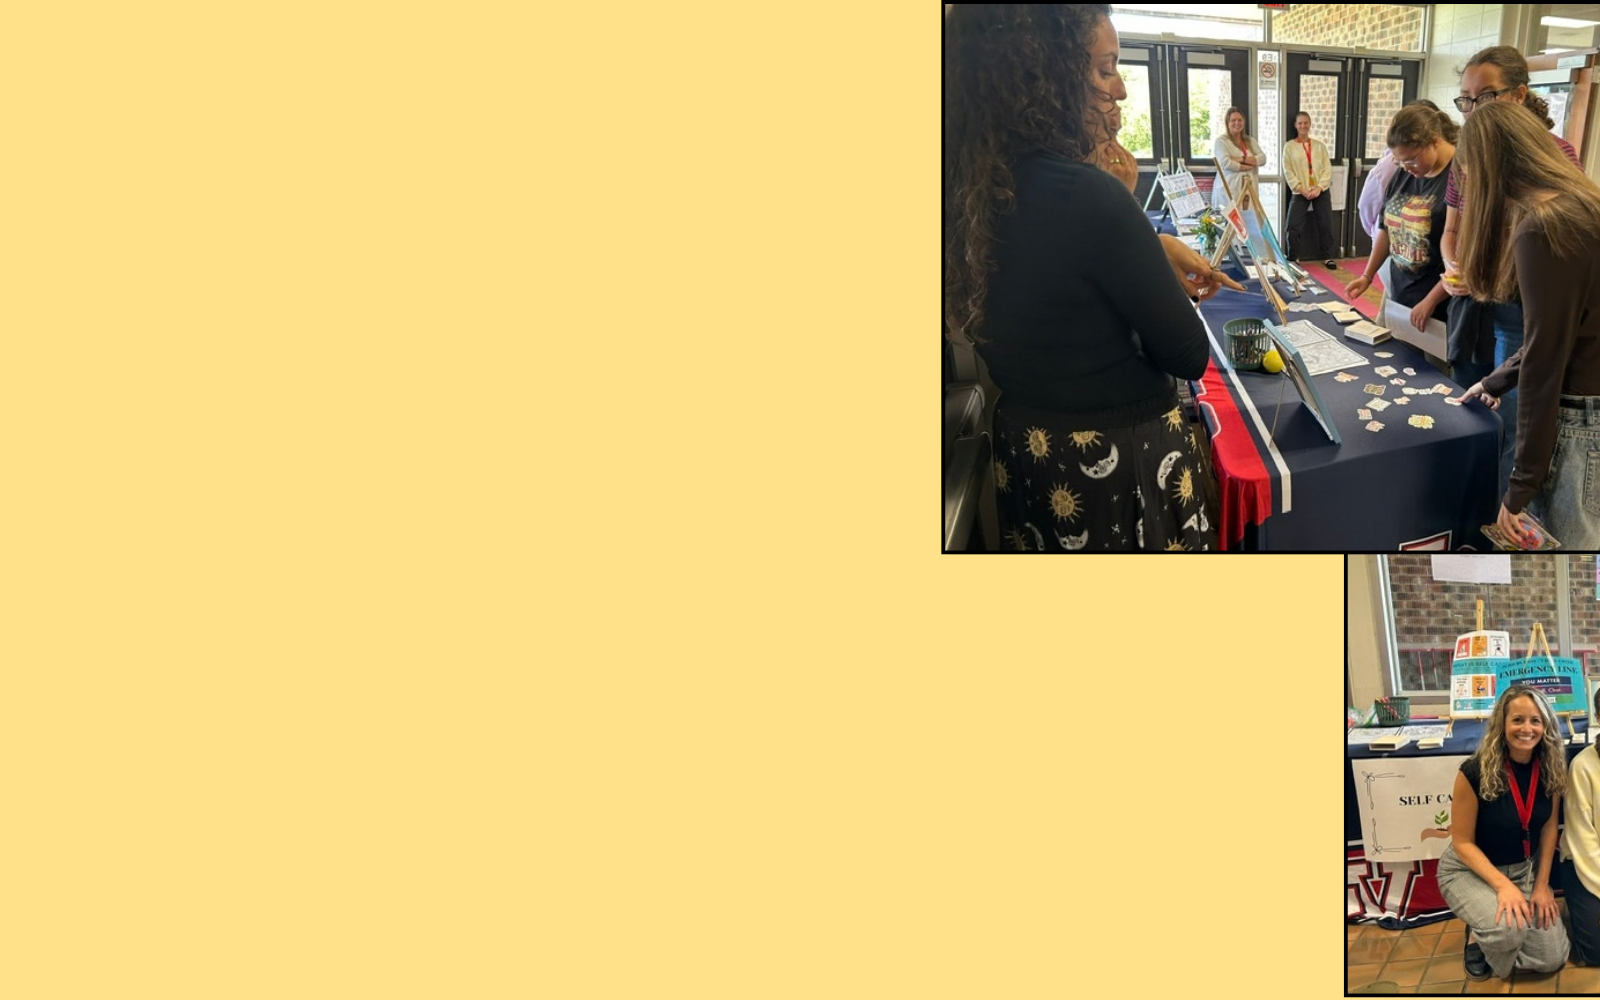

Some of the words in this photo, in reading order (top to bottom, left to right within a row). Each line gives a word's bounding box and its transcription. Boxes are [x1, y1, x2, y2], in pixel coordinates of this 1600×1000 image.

[1500, 664, 1555, 679] EMERGENCY
[1557, 664, 1578, 675] LINE
[1399, 794, 1433, 806] SELF
